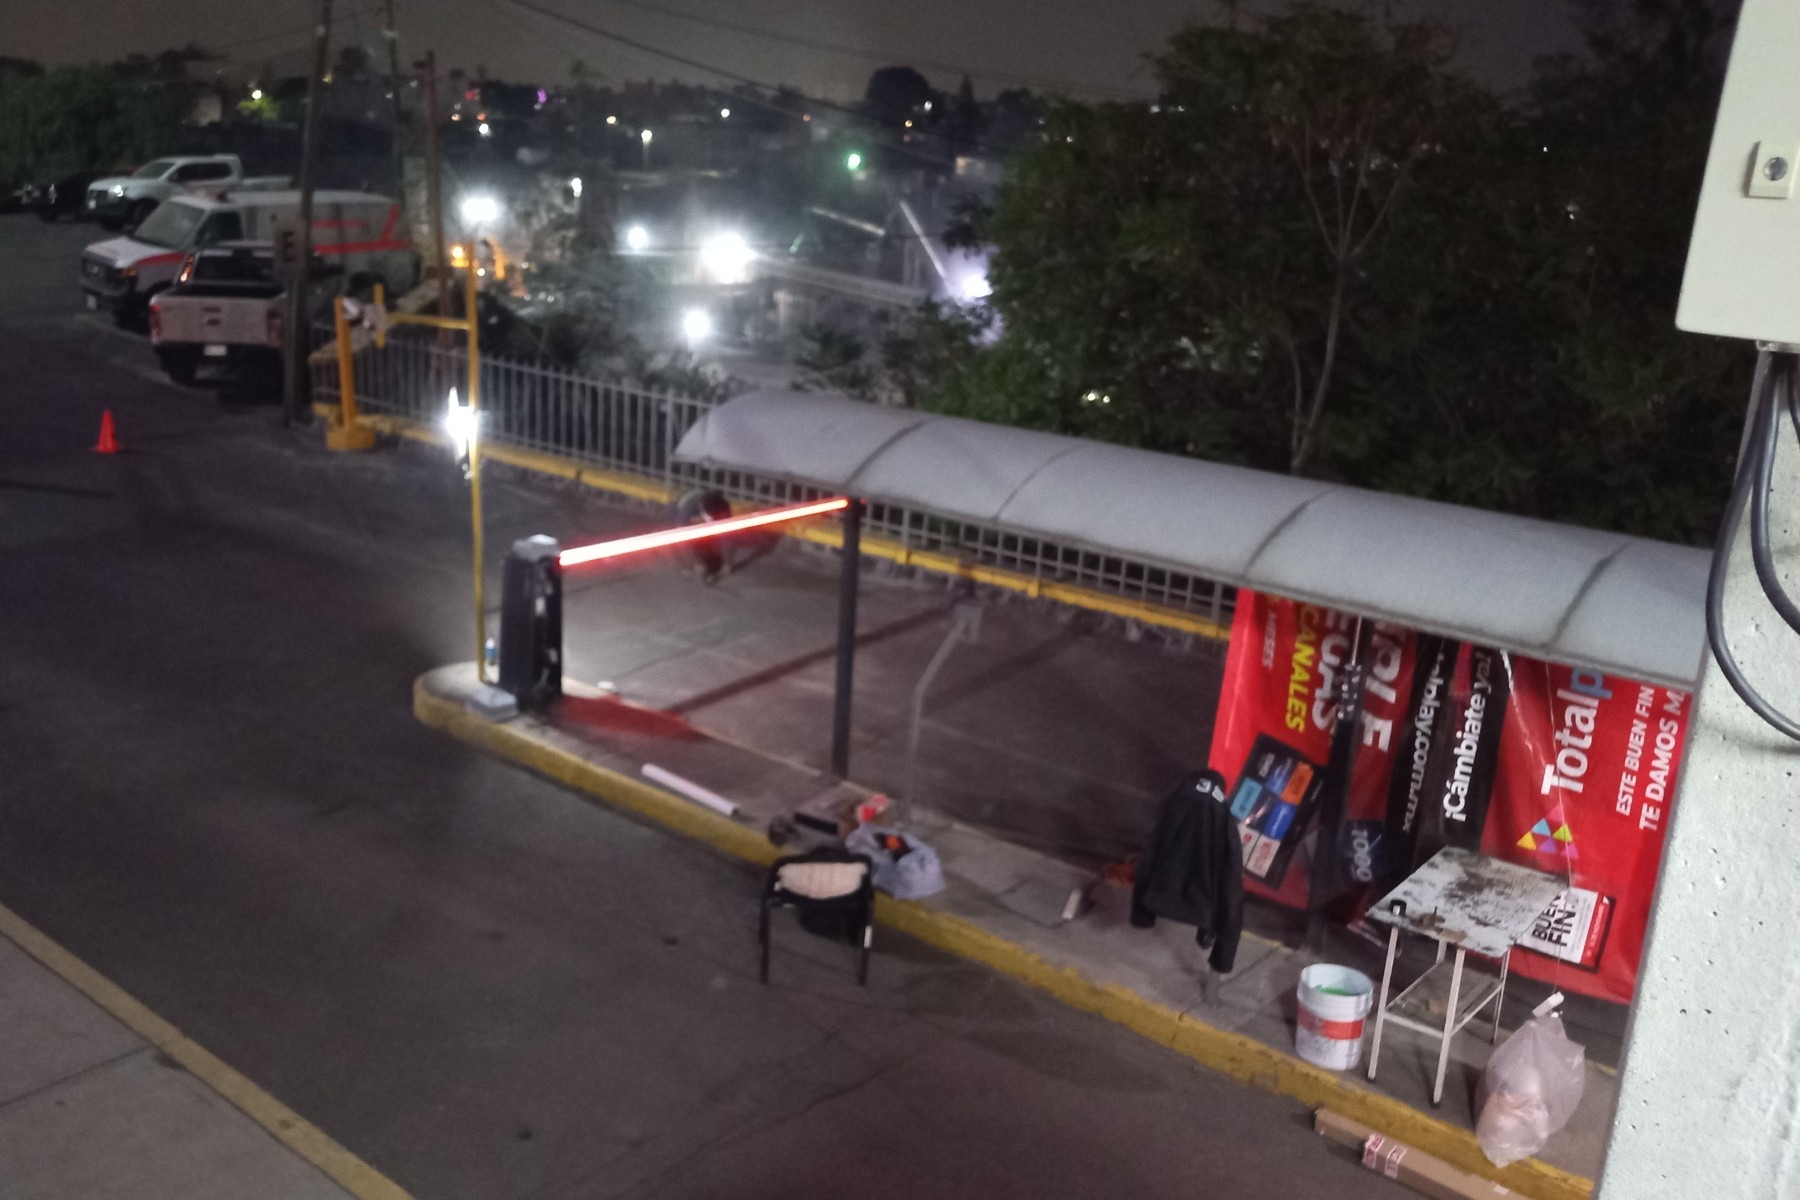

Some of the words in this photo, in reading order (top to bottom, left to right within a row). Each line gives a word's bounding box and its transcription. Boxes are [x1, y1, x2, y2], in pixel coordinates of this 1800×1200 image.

[1285, 604, 1319, 733] CANALES
[1635, 684, 1656, 717] FIN
[1443, 691, 1486, 823] ¡Cámbiate
[1624, 718, 1648, 772] BUEN
[1645, 717, 1680, 804] DAMOS
[1615, 771, 1638, 817] ESTE
[1638, 803, 1661, 832] TE
